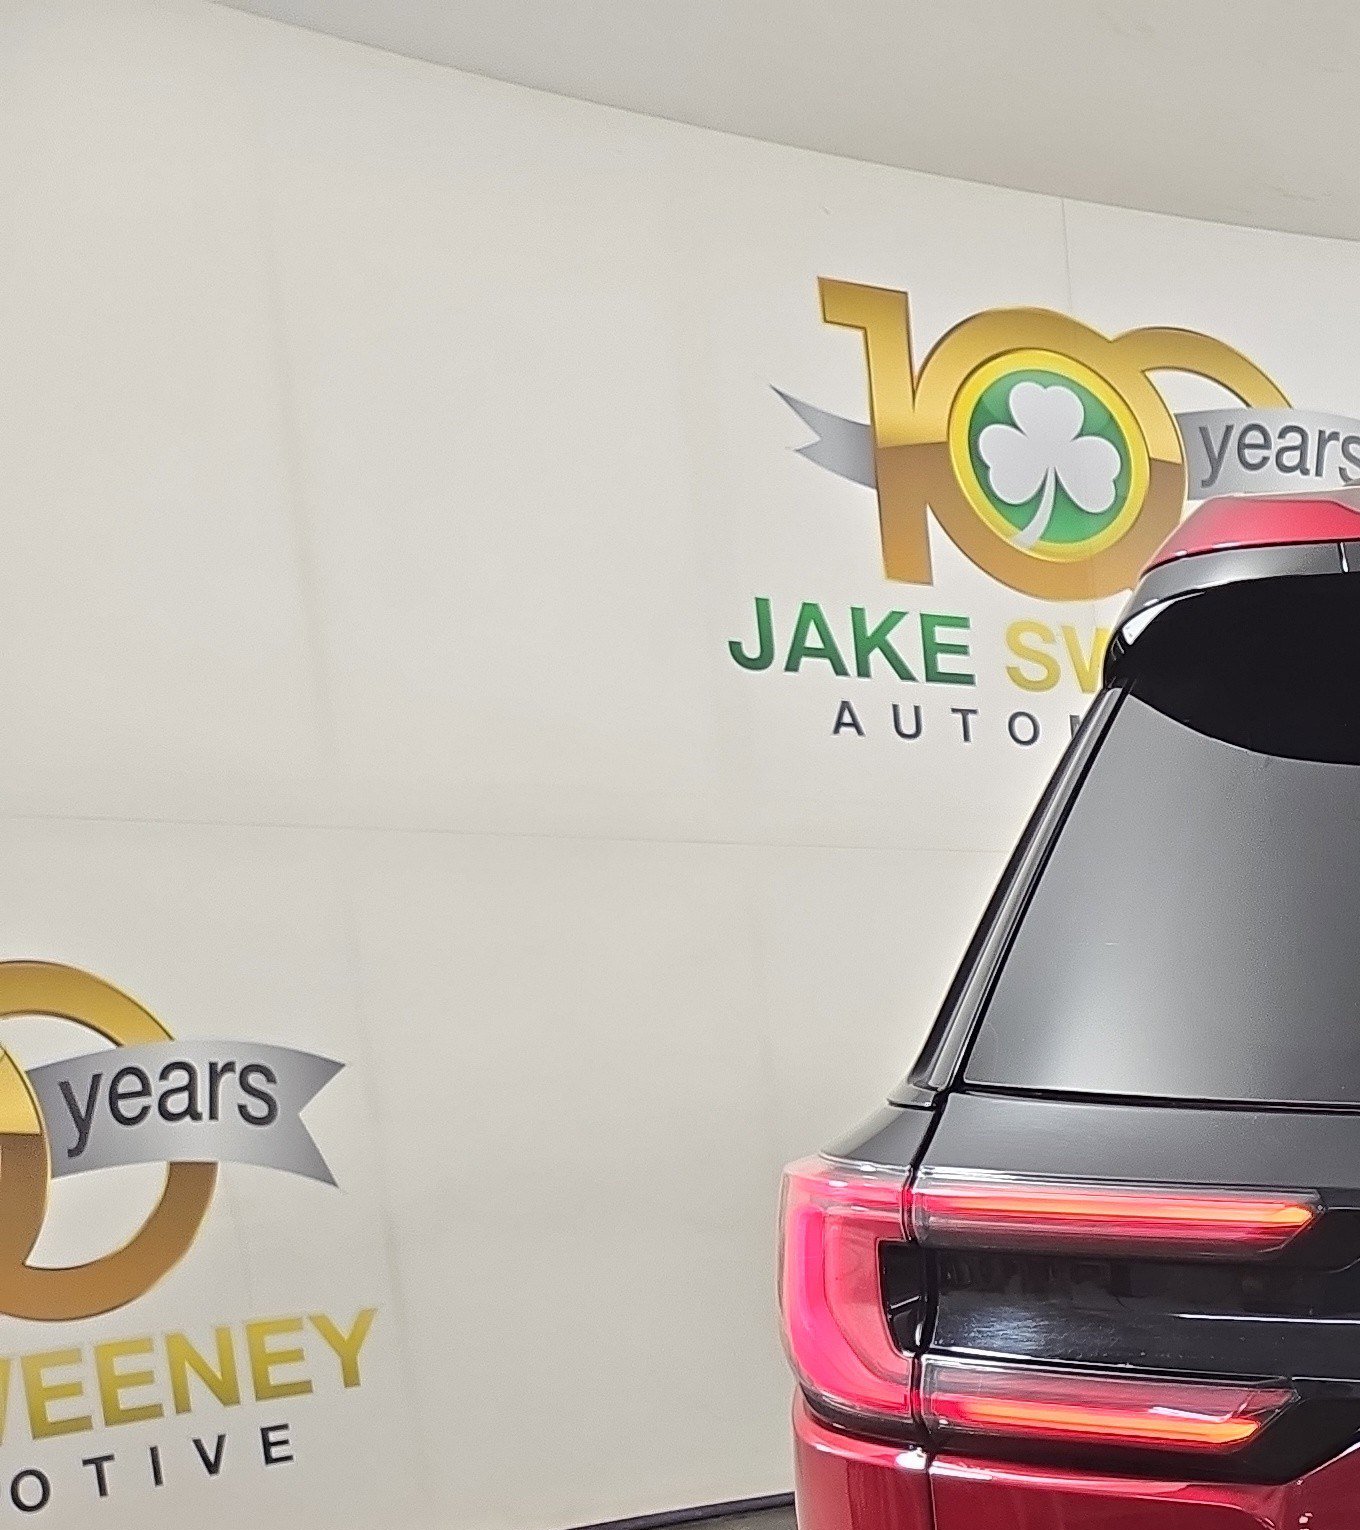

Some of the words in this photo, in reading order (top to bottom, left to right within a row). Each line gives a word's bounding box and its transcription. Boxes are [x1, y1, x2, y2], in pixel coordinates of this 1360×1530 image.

[727, 597, 977, 687] JAKE
[831, 700, 1082, 748] AUTO
[58, 1059, 279, 1157] years
